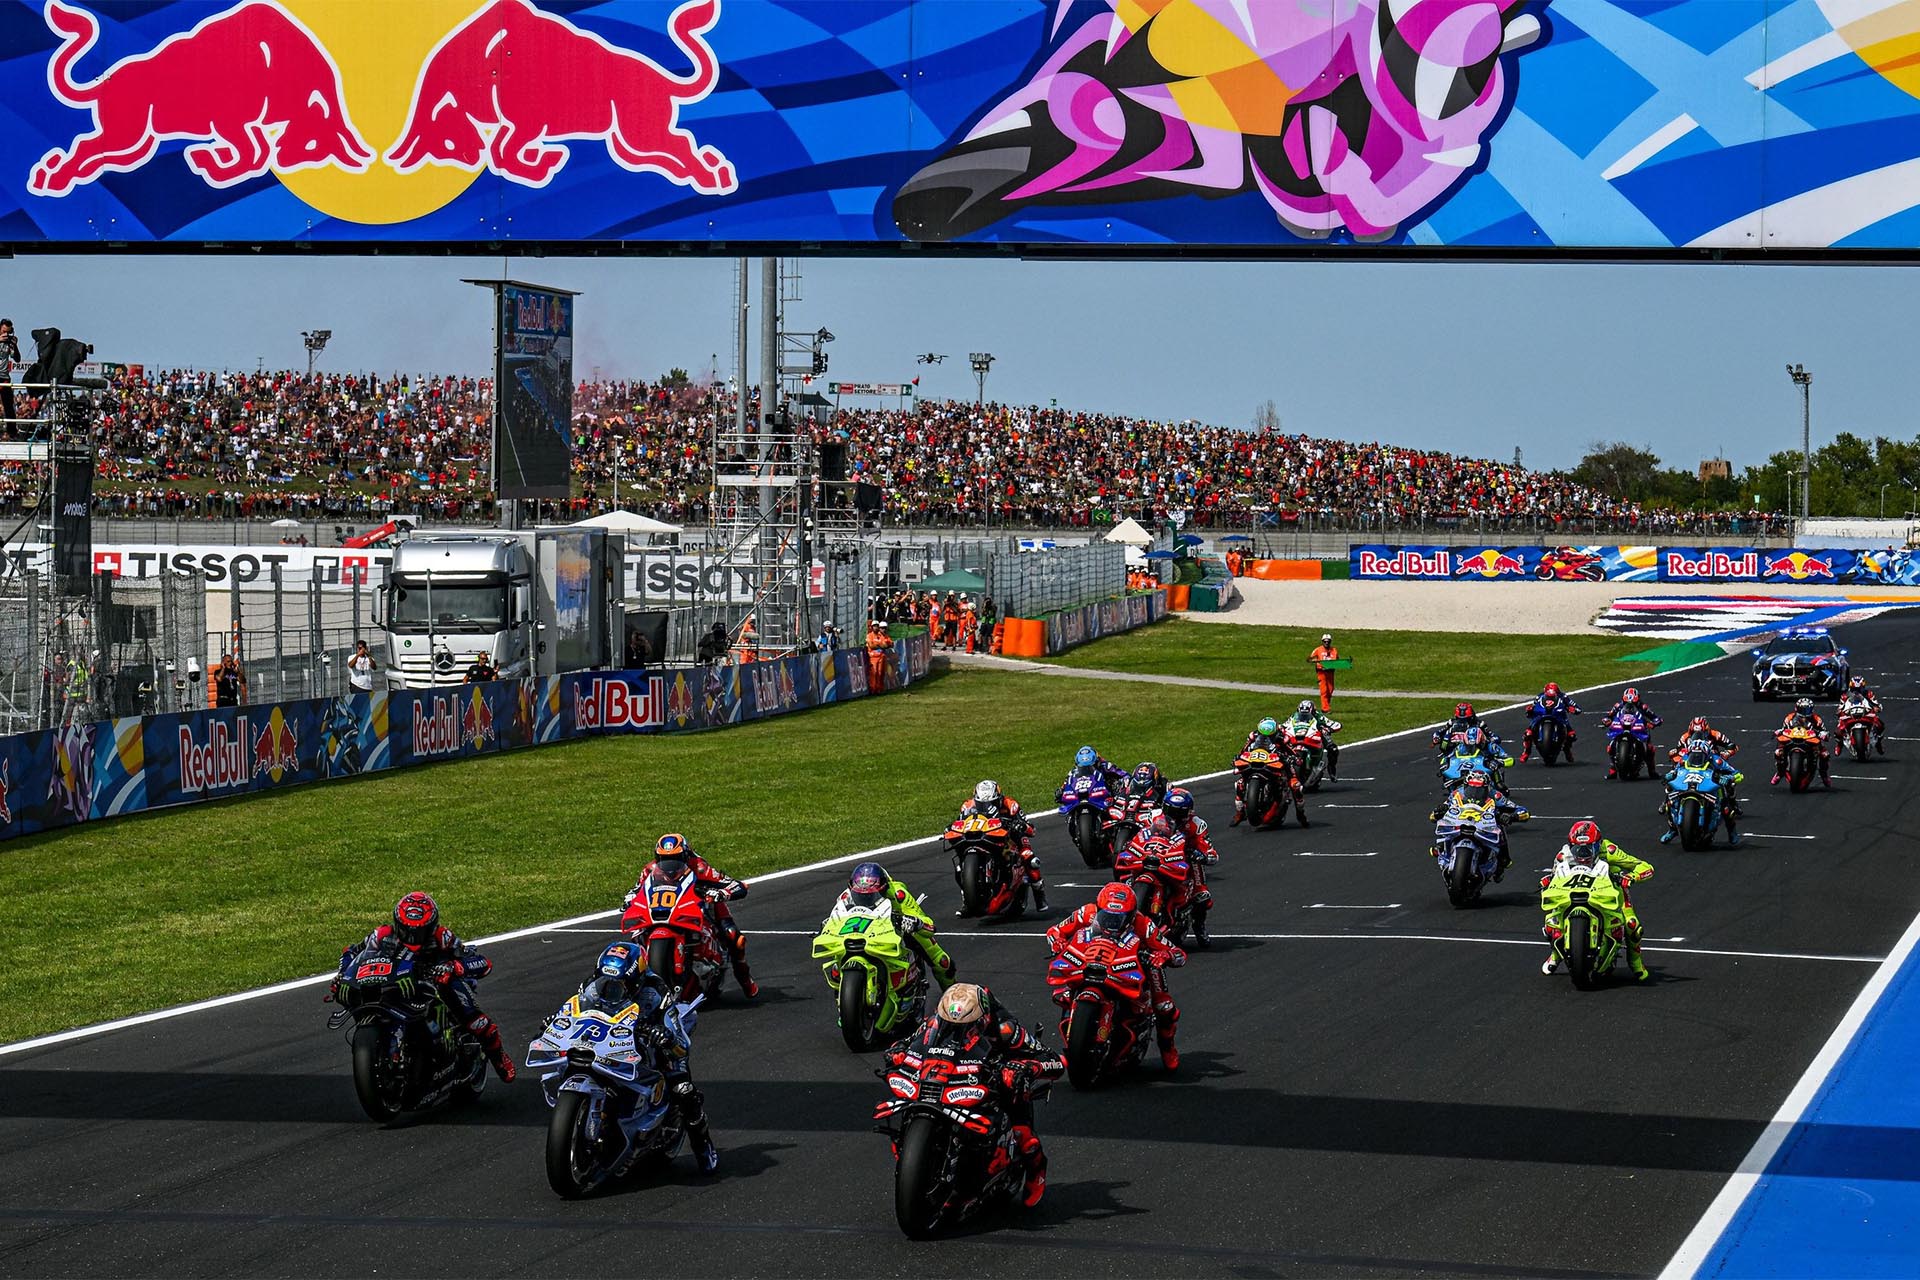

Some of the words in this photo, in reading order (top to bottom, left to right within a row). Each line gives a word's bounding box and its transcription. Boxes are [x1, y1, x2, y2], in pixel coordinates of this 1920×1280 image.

[129, 553, 288, 582] TISSOT
[1563, 873, 1596, 889] 49
[649, 891, 677, 908] 10
[839, 916, 873, 935] 21
[1063, 951, 1083, 966] Lenovo
[1111, 961, 1137, 971] Lenovo
[355, 962, 393, 980] 20
[928, 1047, 955, 1057] aprilia
[890, 1078, 915, 1096] sterilgarda
[948, 1088, 984, 1101] sterilgarda
